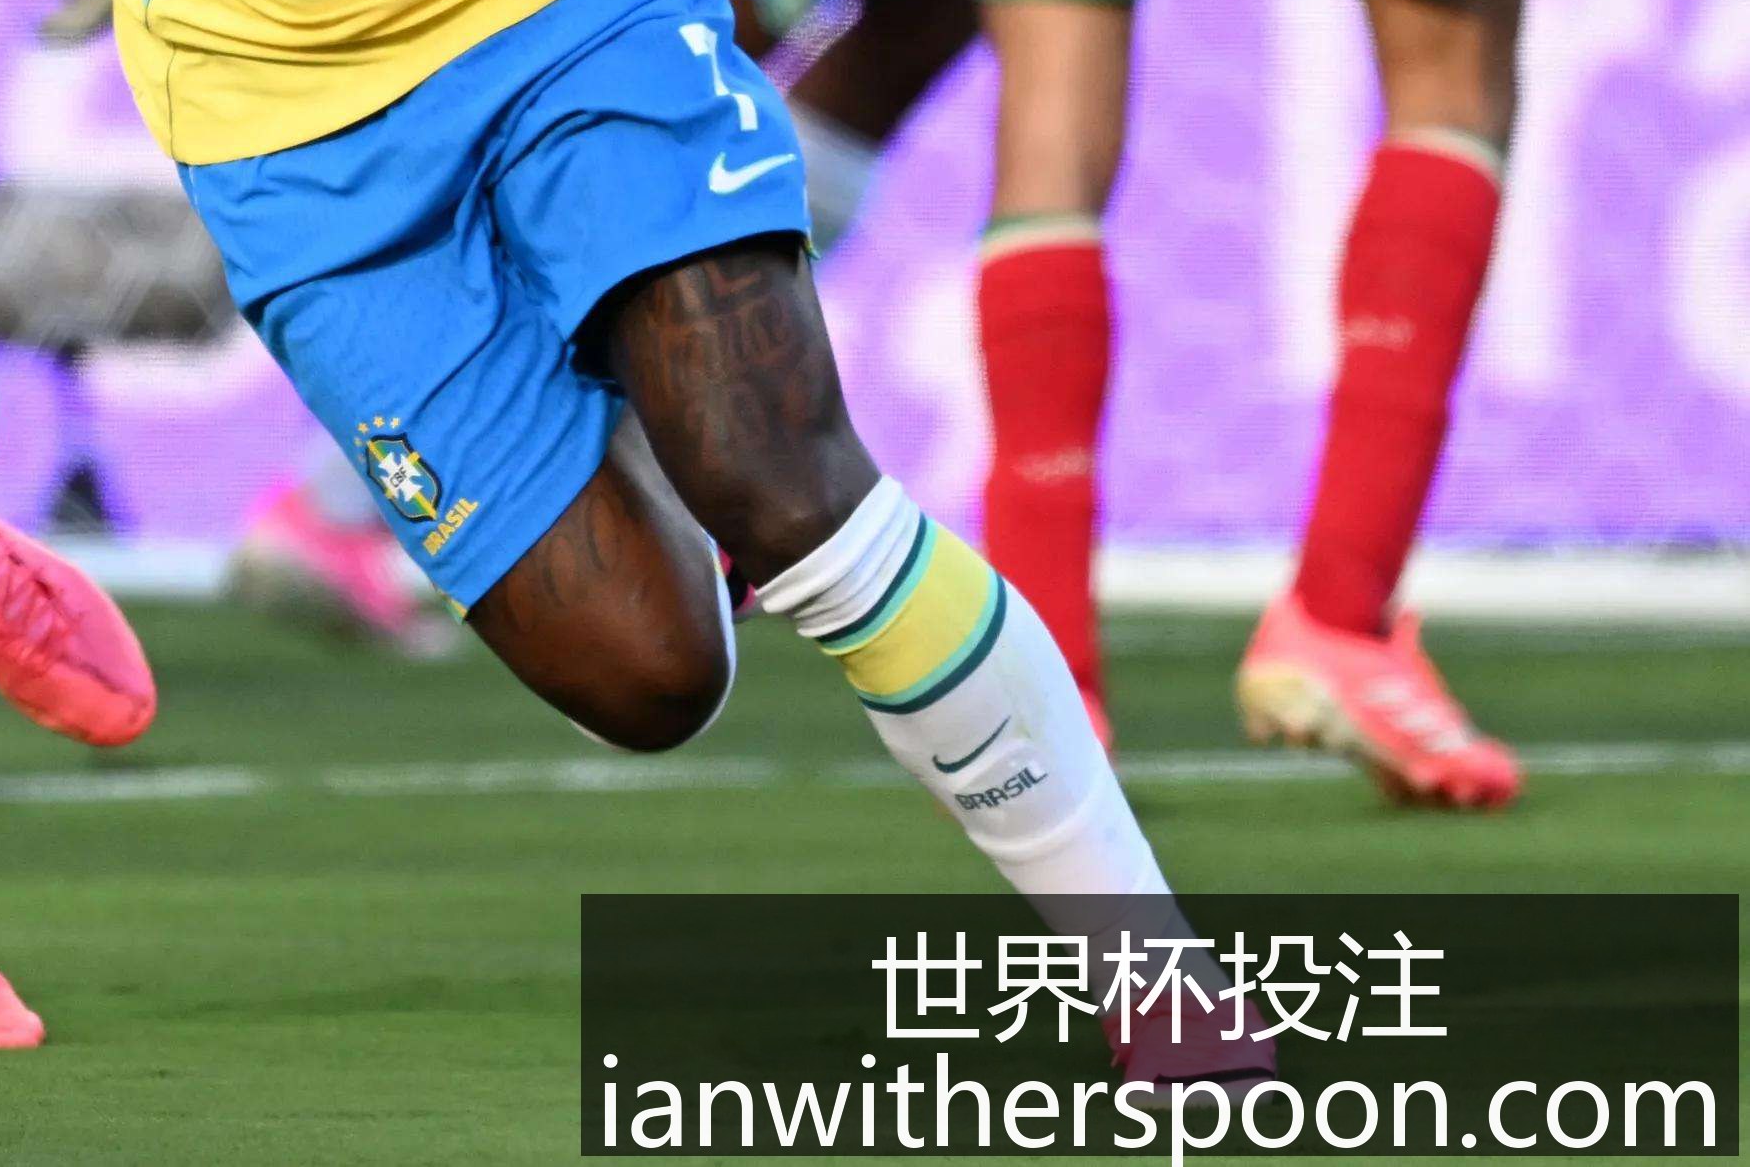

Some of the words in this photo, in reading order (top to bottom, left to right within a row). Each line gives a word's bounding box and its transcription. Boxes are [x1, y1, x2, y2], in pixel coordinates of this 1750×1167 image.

[678, 22, 759, 131] 7
[390, 466, 407, 488] CBF
[422, 497, 479, 556] BRASIL
[954, 766, 1049, 811] BRASIL
